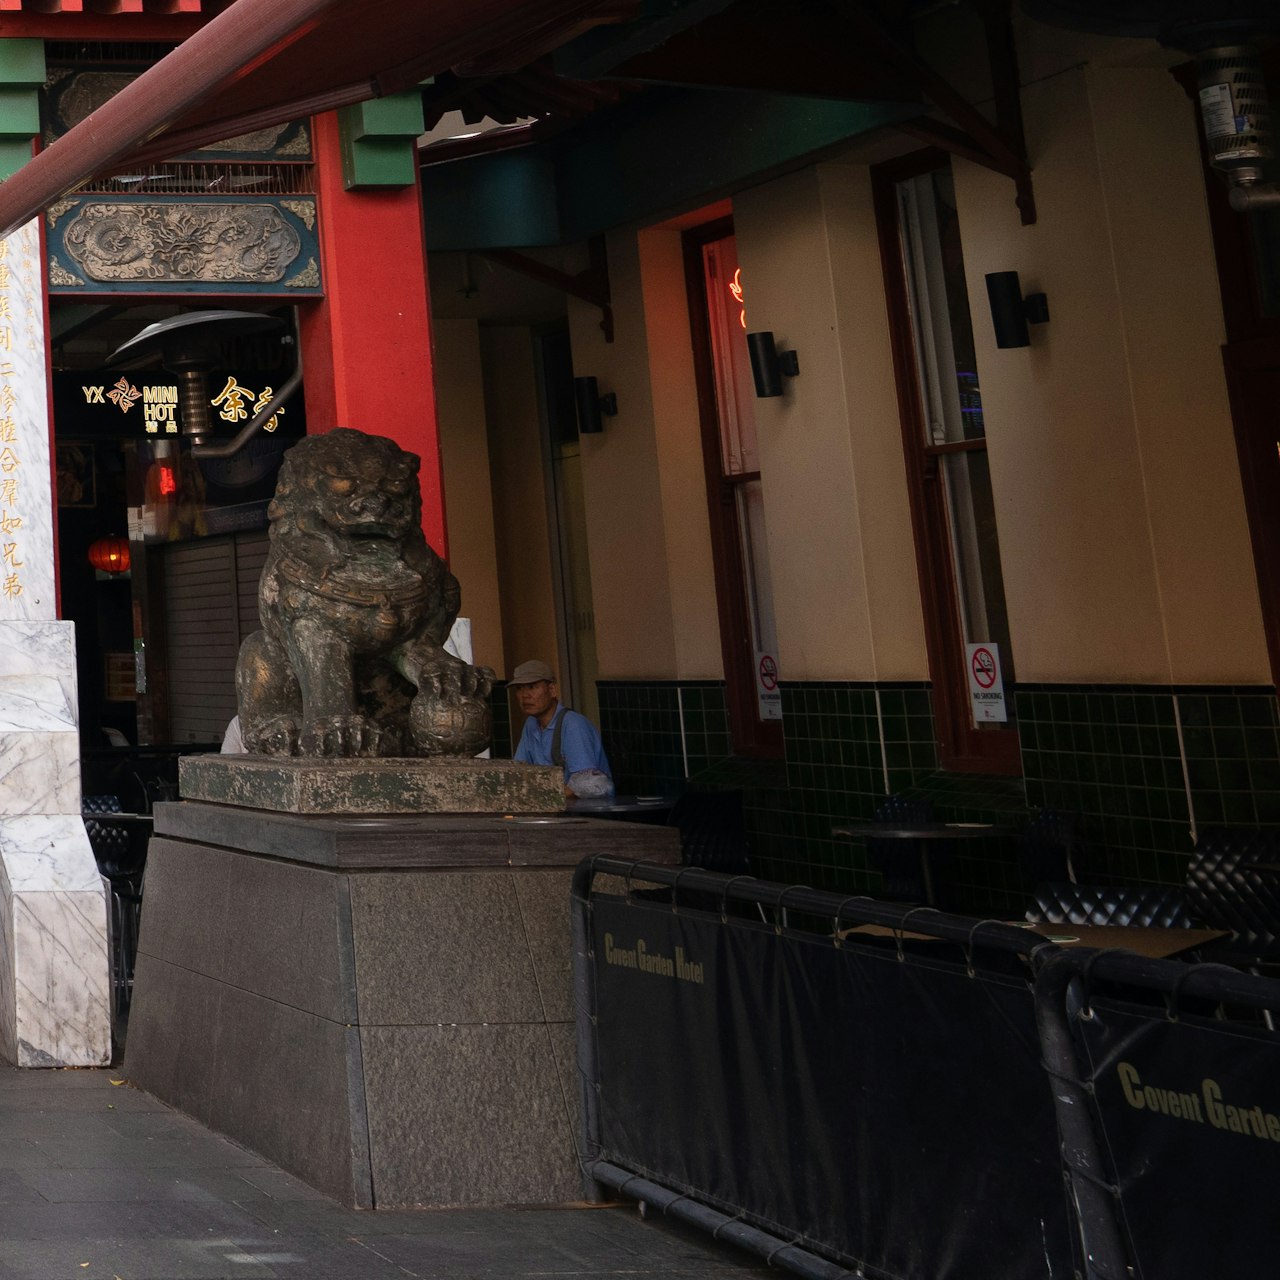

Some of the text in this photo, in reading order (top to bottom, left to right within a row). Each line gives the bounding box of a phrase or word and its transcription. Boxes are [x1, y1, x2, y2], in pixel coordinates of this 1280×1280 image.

[82, 386, 178, 404] YX MINI
[144, 404, 176, 421] HOT
[604, 932, 704, 984] Covent Garden Hotel
[1117, 1061, 1204, 1123] Covent
